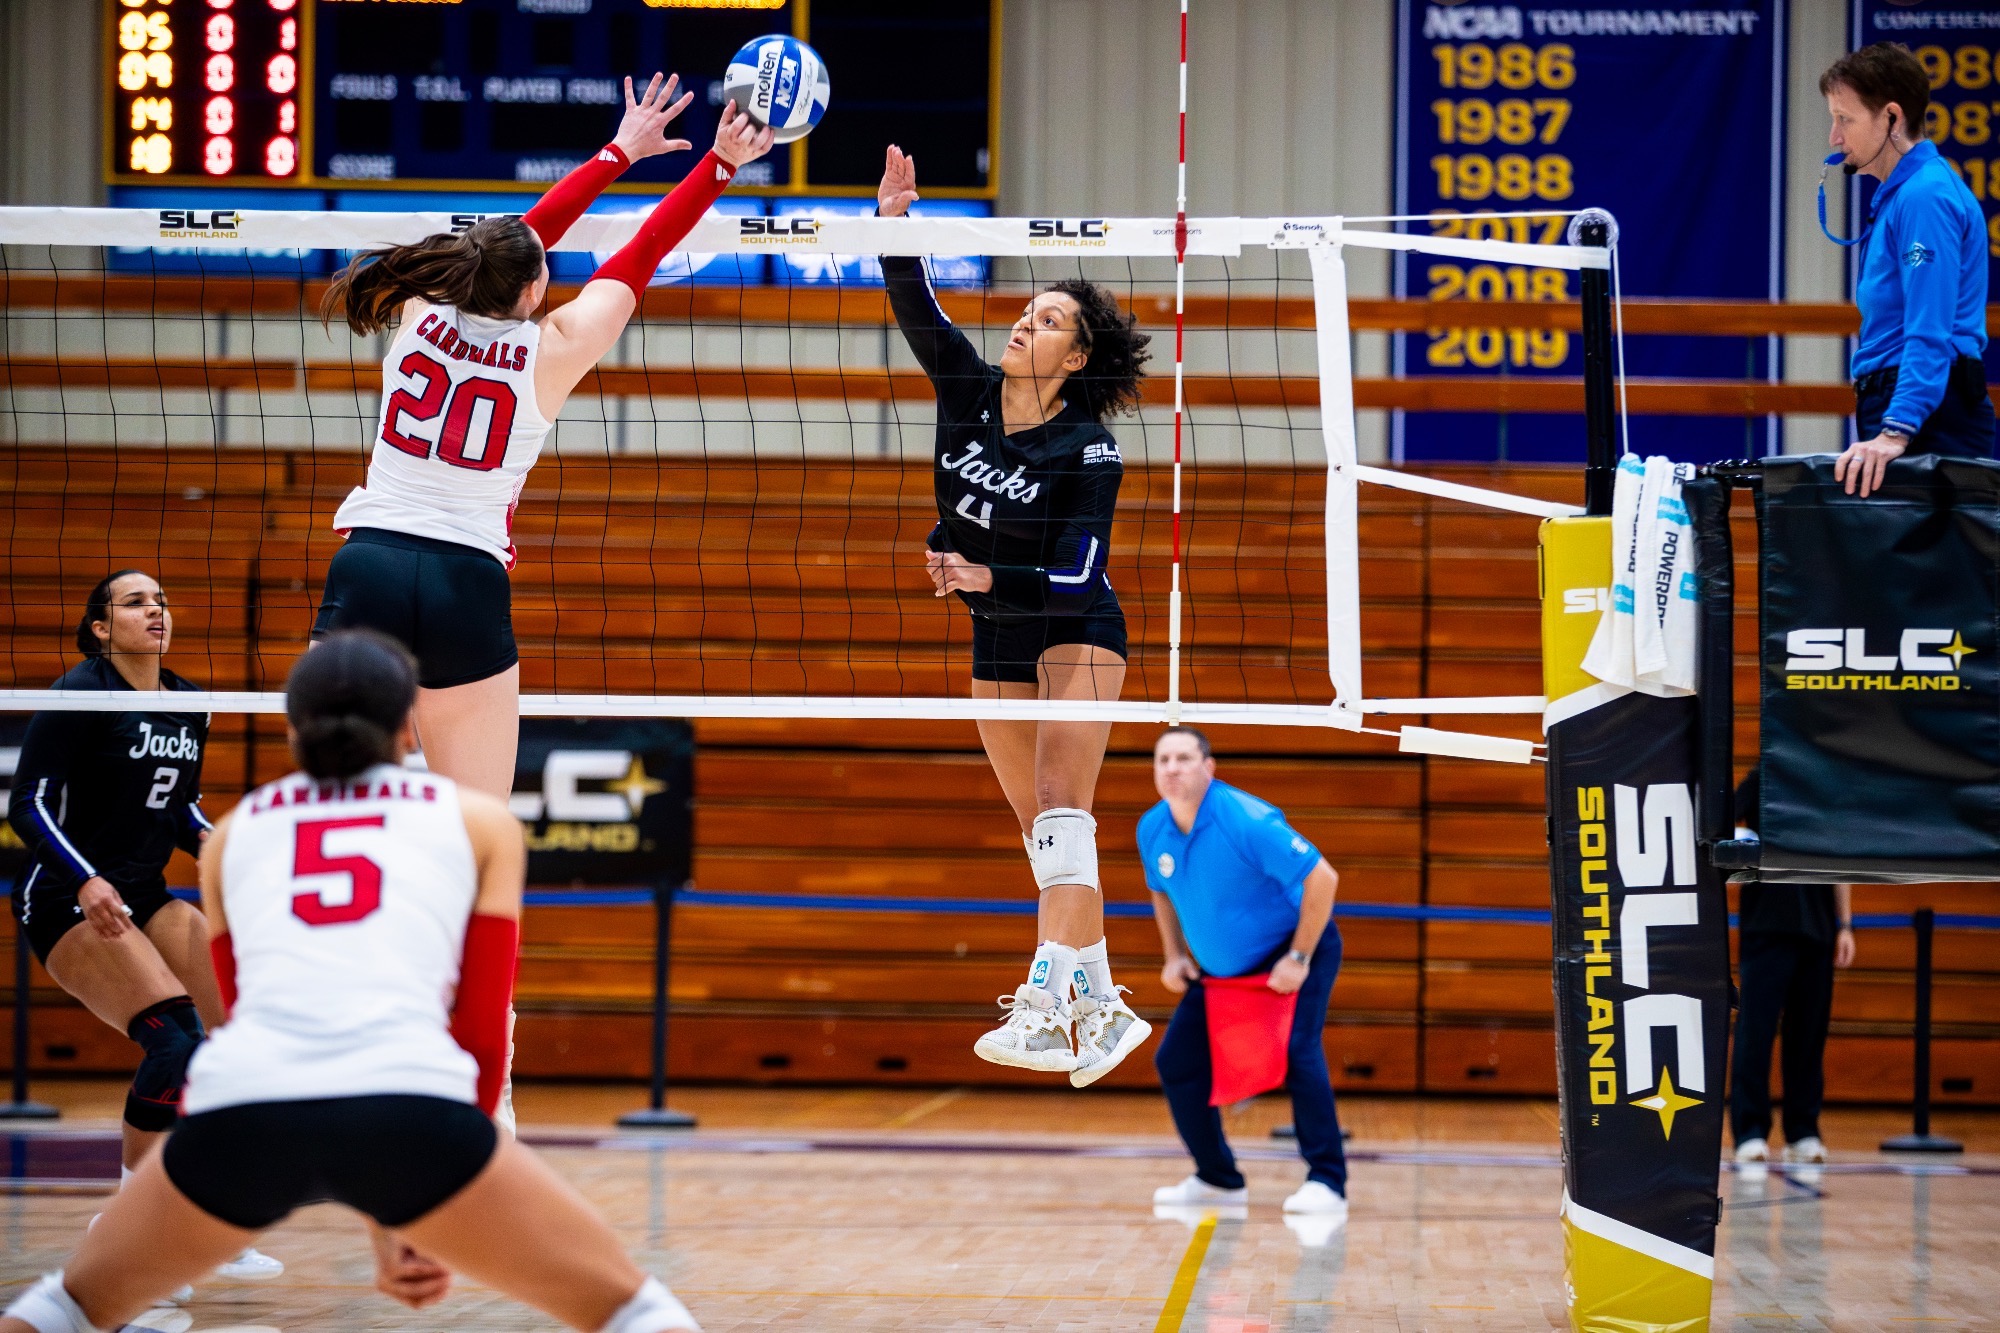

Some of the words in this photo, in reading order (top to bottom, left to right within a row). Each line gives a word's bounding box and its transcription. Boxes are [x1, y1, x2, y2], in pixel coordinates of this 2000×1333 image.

[206, 13, 234, 52] 0
[1424, 6, 1523, 39] NCAA
[1530, 10, 1758, 36] TOURNAMENT
[206, 53, 234, 92] 0
[757, 52, 778, 108] molten
[774, 55, 799, 109] NCAA
[1431, 43, 1577, 90] 1986
[1916, 45, 2000, 90] 98
[206, 95, 233, 134] 0
[1430, 98, 1573, 145] 1987
[1924, 102, 2000, 146] 98
[205, 136, 233, 175] 0
[1429, 153, 1575, 201] 1988
[159, 210, 236, 230] SLC
[159, 230, 239, 239] SOUTHLAND
[740, 217, 817, 235] SLC
[1028, 219, 1105, 237] SLC
[1428, 207, 1569, 246] 2017
[1029, 239, 1106, 247] SOUTHLAND
[1427, 264, 1571, 302] 2018
[1426, 324, 1570, 369] 2019
[381, 350, 518, 472] 20
[941, 440, 1041, 504] Jacks
[1083, 456, 1123, 465] SOUTHLA
[955, 493, 993, 530] 4
[1785, 628, 1955, 671] SLC
[1786, 675, 1961, 690] SOUTHLAND
[129, 721, 199, 761] Jacks
[145, 766, 180, 810] 2
[291, 814, 385, 928] 5
[1577, 786, 1617, 1105] SOUTHLAND
[1614, 783, 1706, 1094] SLC
